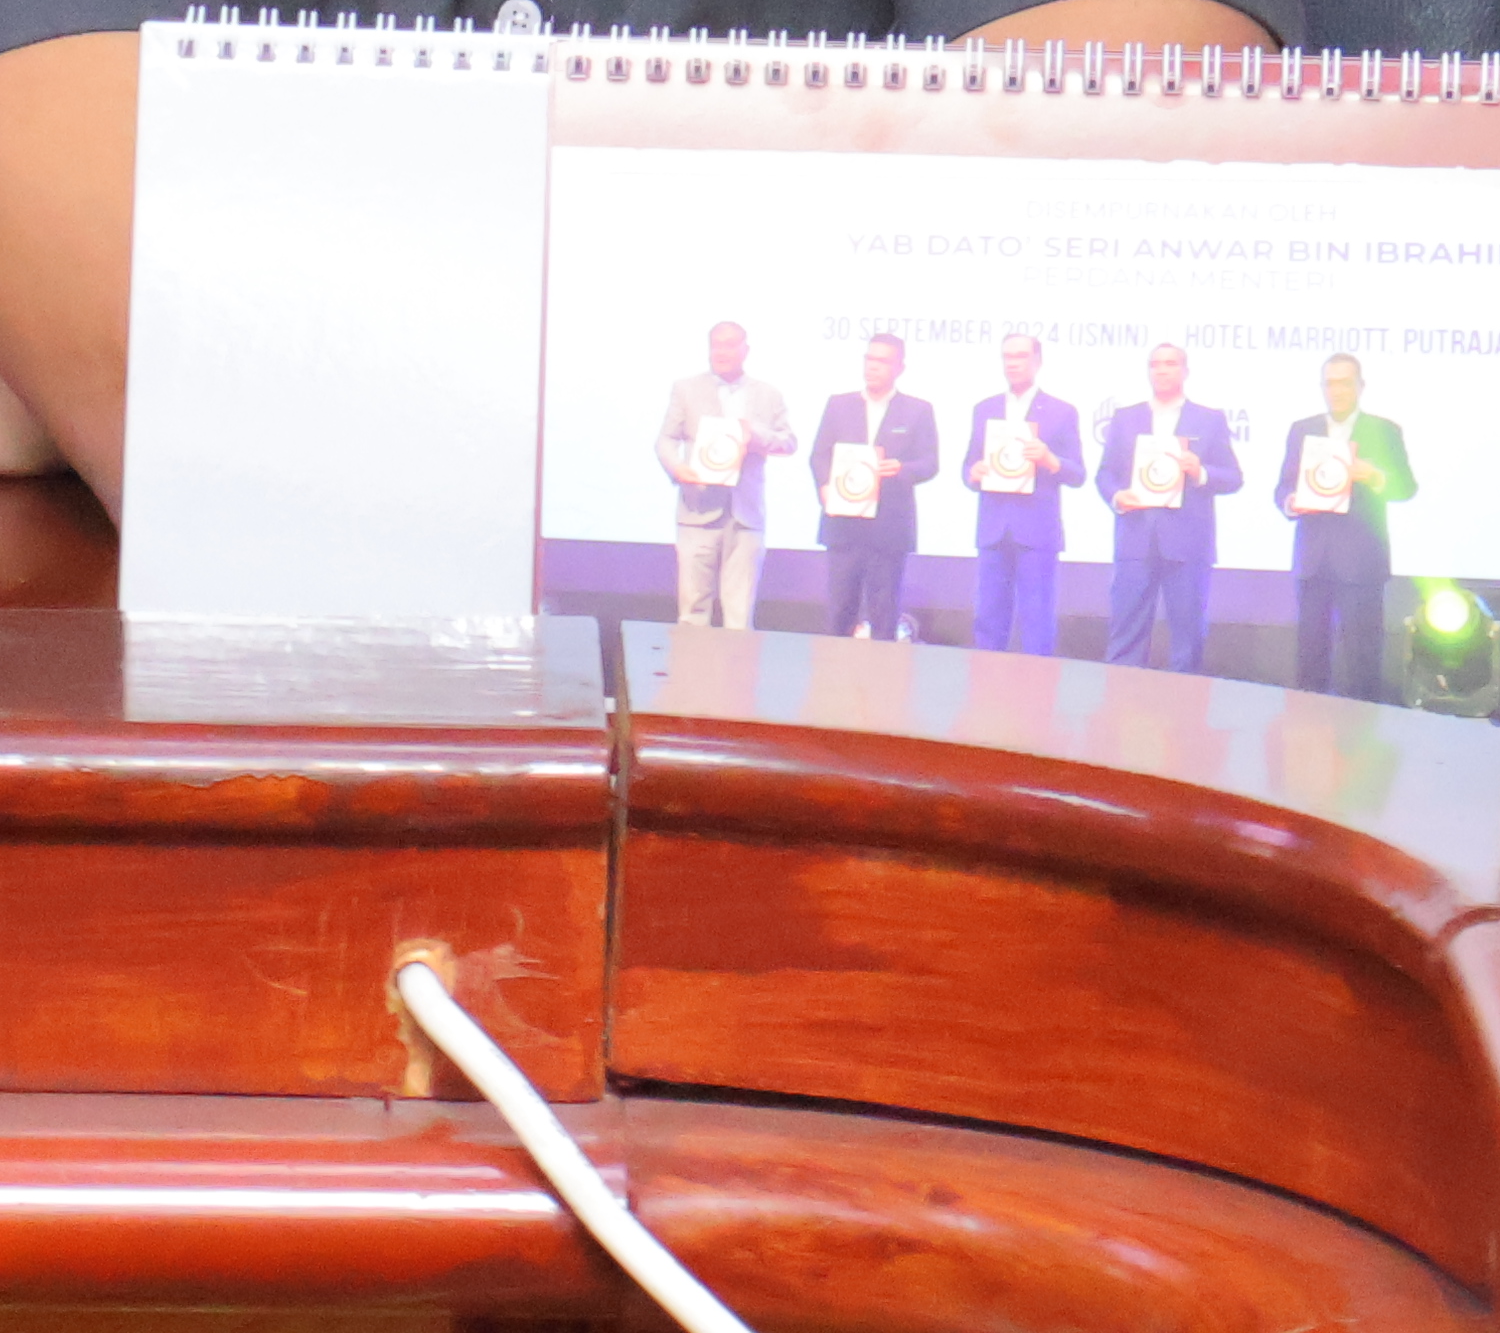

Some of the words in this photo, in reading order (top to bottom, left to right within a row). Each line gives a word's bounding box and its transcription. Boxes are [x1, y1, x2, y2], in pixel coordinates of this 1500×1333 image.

[1025, 199, 1258, 222] DISEMPURNAKAN
[1267, 202, 1337, 223] OLEH
[847, 233, 914, 256] YAB
[1043, 236, 1119, 259] SERI
[1132, 238, 1273, 262] ANWAR
[1288, 240, 1350, 263] BIN
[1022, 265, 1179, 288] PERDANA
[1190, 269, 1335, 292] MENTERI
[821, 315, 851, 341] 30
[858, 317, 993, 345] SEPTEMBER
[1067, 322, 1149, 348] (ISNIN)
[1184, 323, 1259, 351] HOTEL
